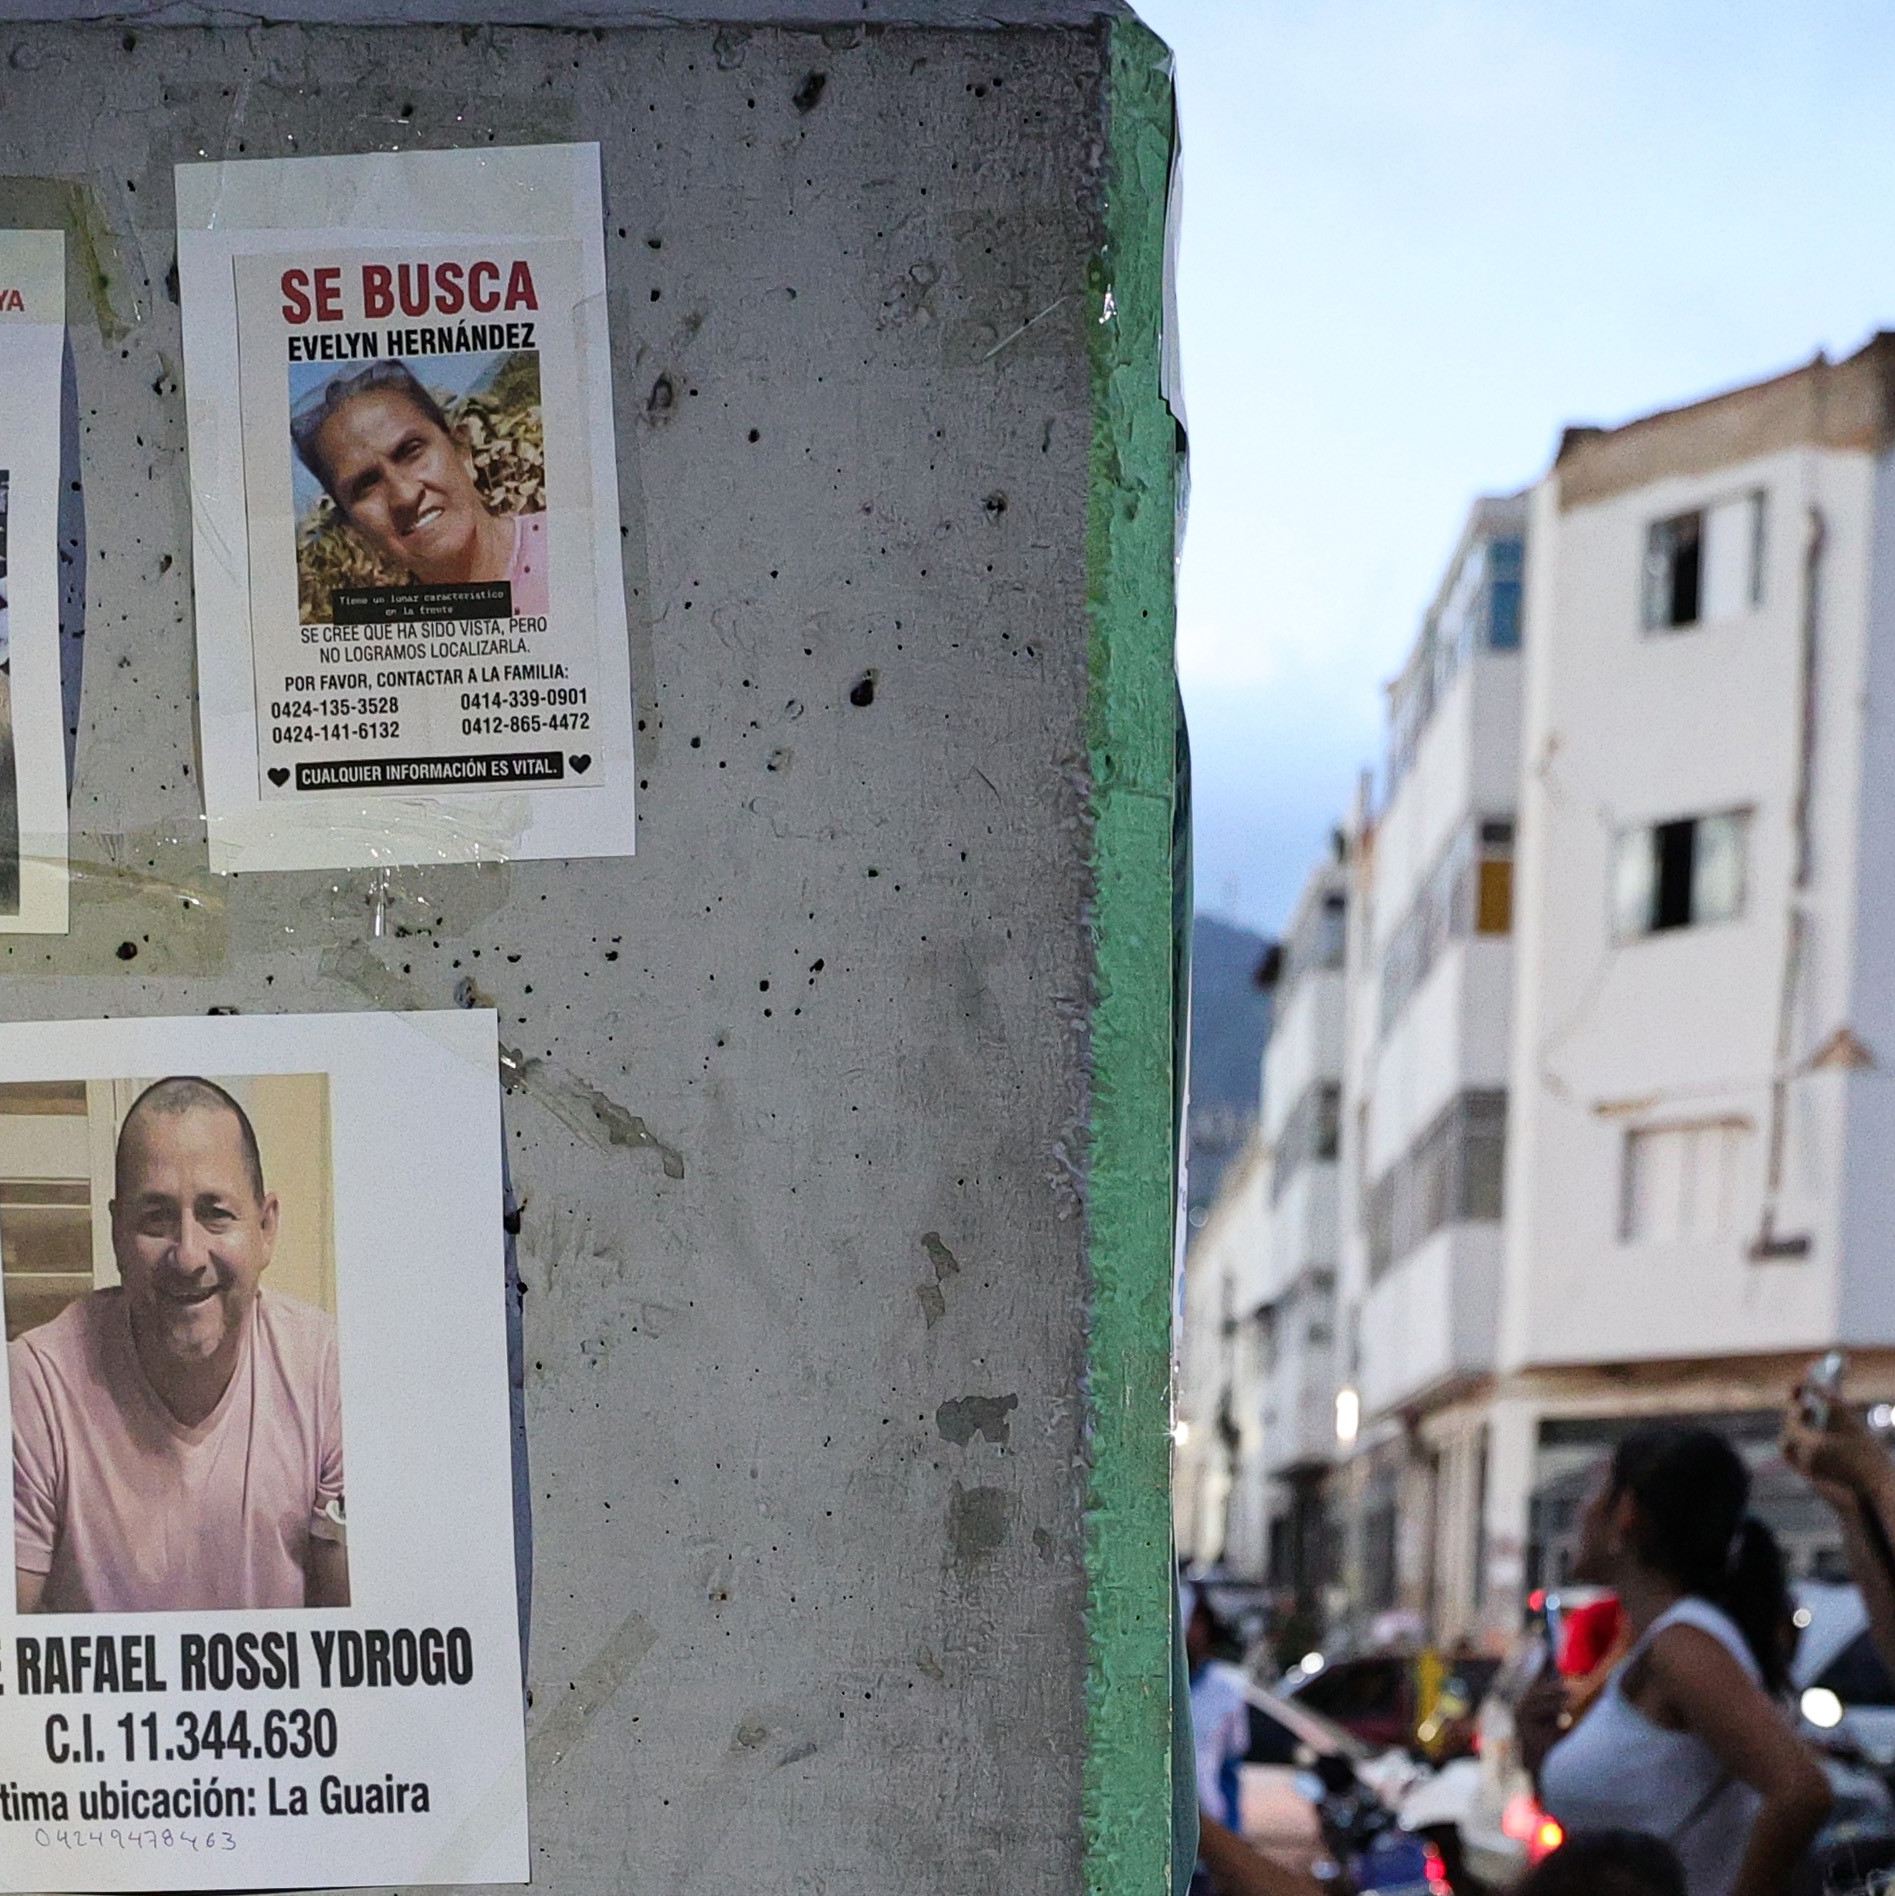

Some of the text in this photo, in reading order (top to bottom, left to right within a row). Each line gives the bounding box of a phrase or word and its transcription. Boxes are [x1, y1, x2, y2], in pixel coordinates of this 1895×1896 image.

[281, 260, 539, 325] SE BUSCA
[287, 319, 537, 361] EVELYN HERNÁNDEZ
[300, 626, 319, 644] SE
[322, 624, 359, 642] CREE
[363, 623, 392, 641] QUE
[396, 622, 417, 639] HA
[420, 621, 456, 638] SIDO
[508, 618, 547, 633] PERO
[319, 646, 340, 663] NO
[344, 642, 426, 662] LOGRAMOS
[284, 675, 315, 692] POR
[376, 668, 463, 688] CONTACTAR
[467, 667, 478, 684] A
[481, 665, 500, 682] LA
[270, 696, 399, 719] 0424-135-3528
[460, 687, 586, 710] 0414-339-0901
[271, 720, 399, 744] 0424-141-6132
[461, 711, 590, 735] 0412-865-4472
[301, 765, 381, 785] CUALQUIER
[385, 757, 486, 780] INFORMACIÓN
[490, 760, 509, 777] ES
[15, 1634, 167, 1695] RAFAEL
[180, 1630, 299, 1691] ROSSI
[310, 1626, 473, 1688] YDROGO
[116, 1707, 337, 1762] 11.344.630
[268, 1776, 308, 1816] La
[319, 1772, 430, 1815] Guaira
